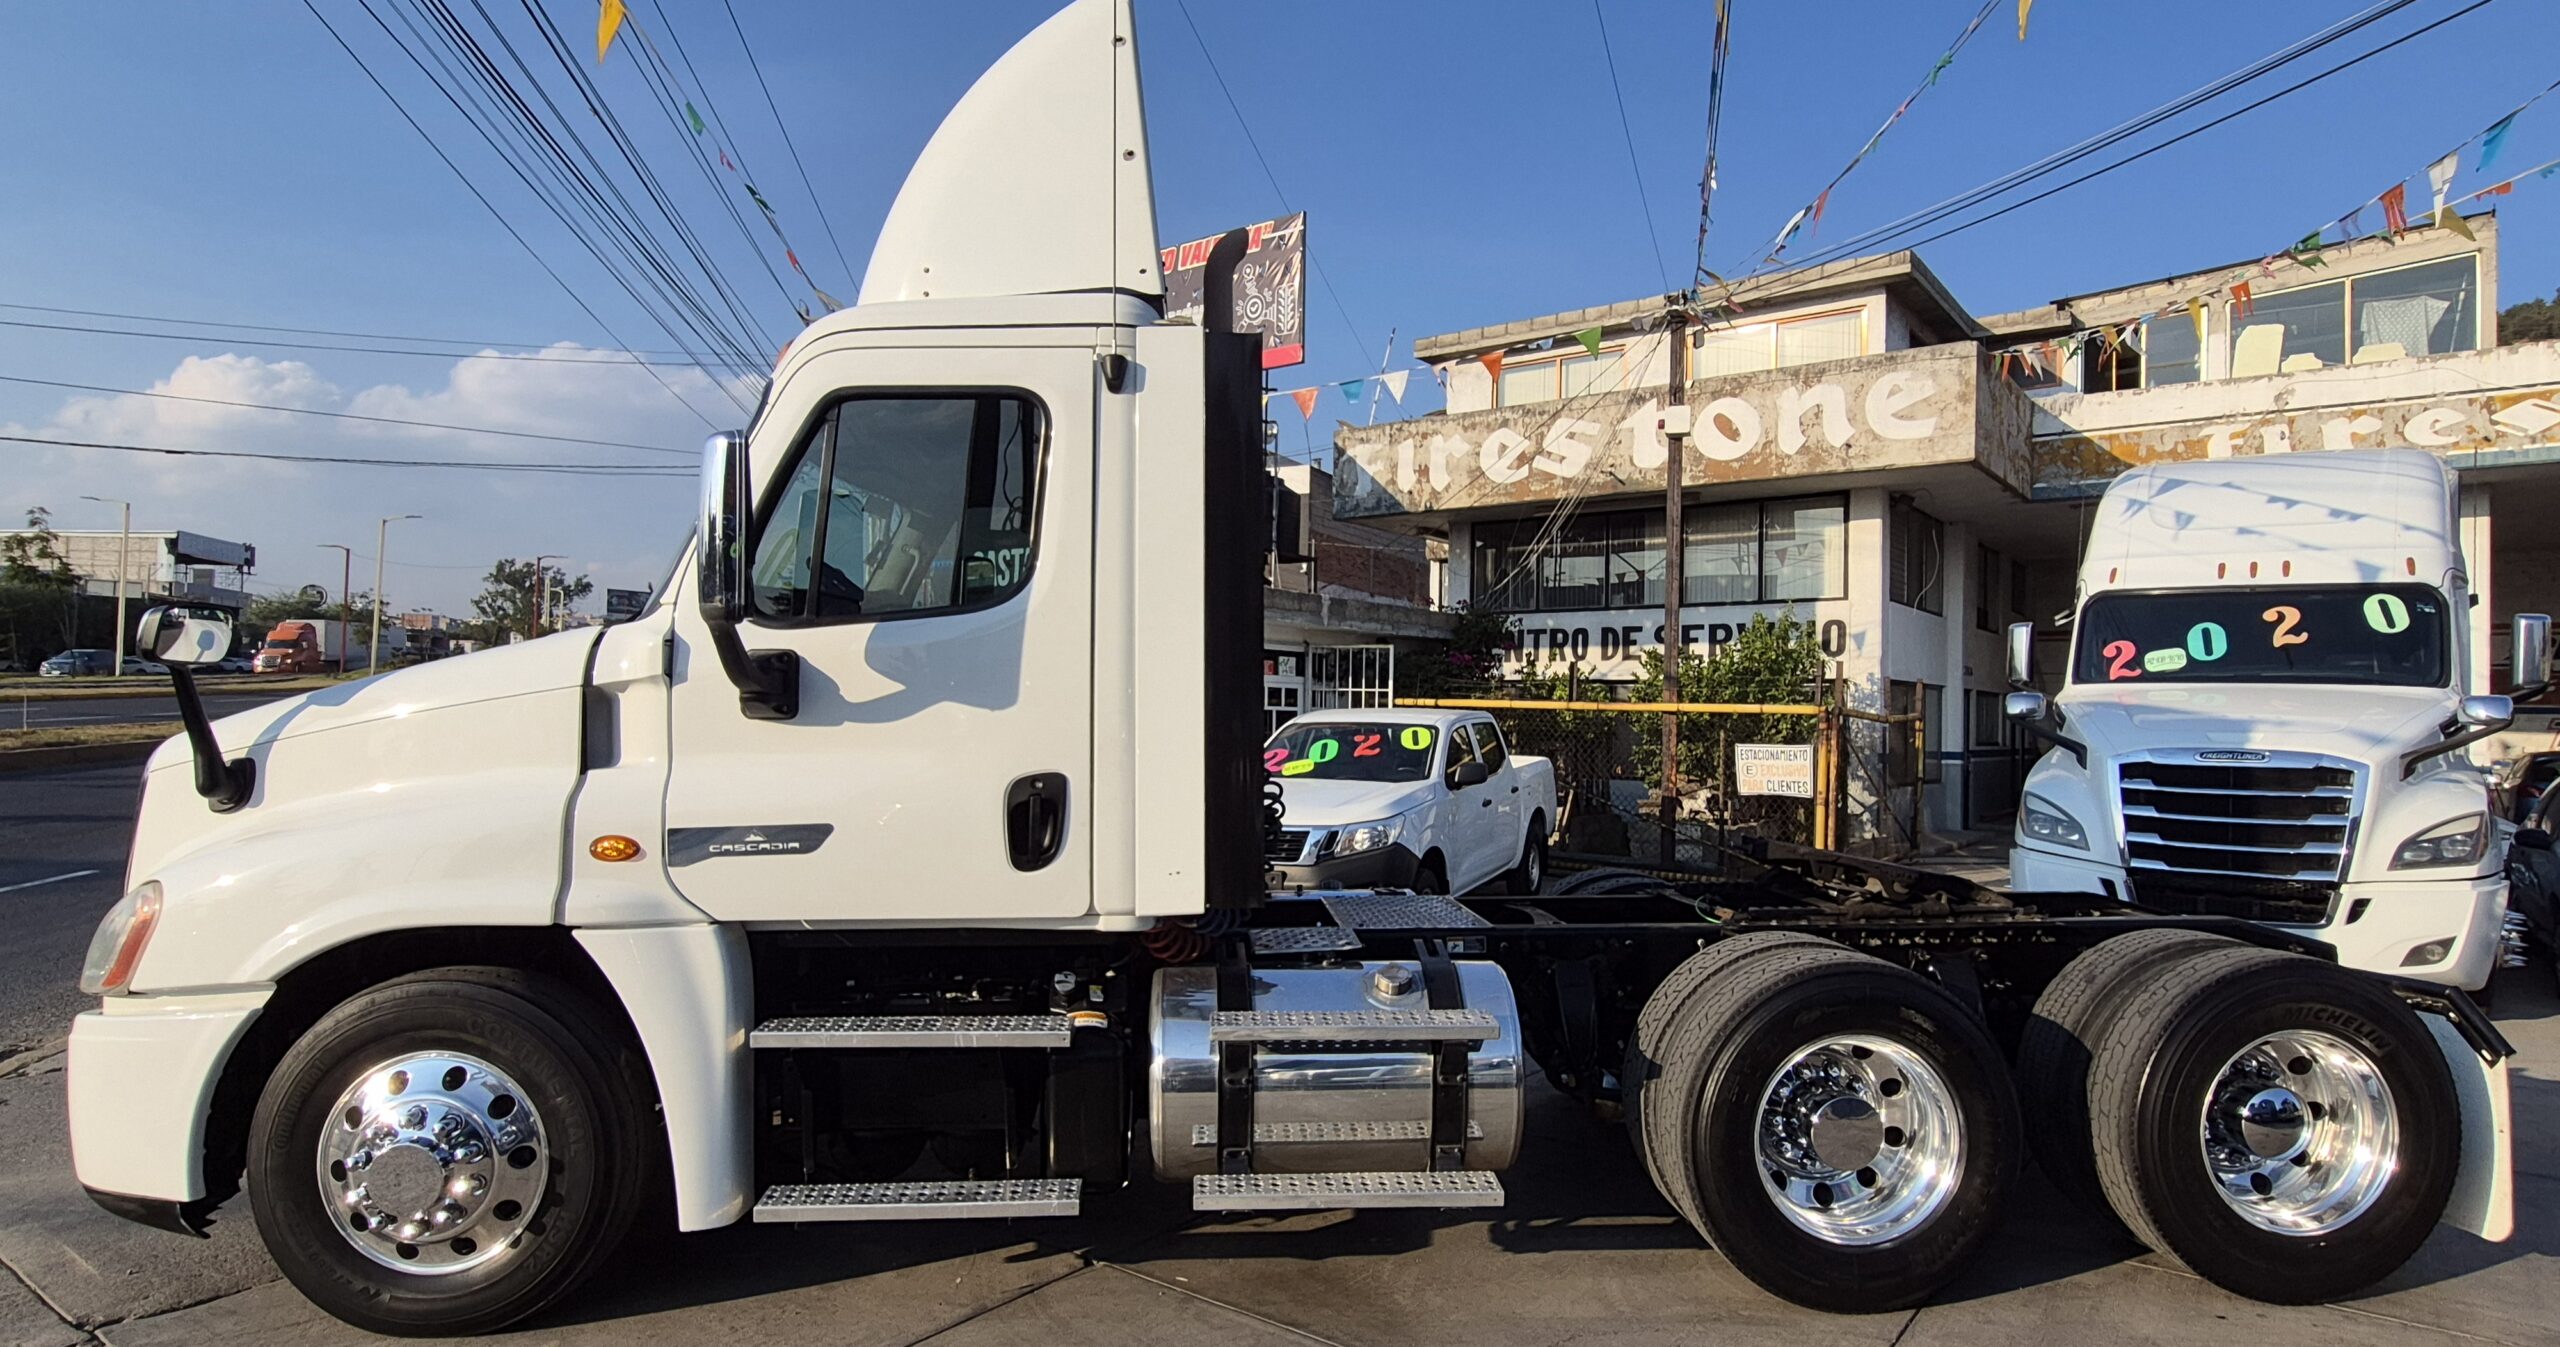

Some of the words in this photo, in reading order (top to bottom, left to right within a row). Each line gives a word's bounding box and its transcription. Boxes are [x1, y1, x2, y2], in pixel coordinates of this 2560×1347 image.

[1503, 627, 1589, 662] NTRO
[1600, 626, 1643, 661] DE
[1740, 749, 1808, 761] ESTACIONAMIENTO
[1760, 765, 1808, 778] EXCLUSIVO
[1743, 779, 1764, 792] PARA
[1766, 780, 1809, 794] CLIENTES
[709, 842, 800, 853] CASCADIA
[2284, 1004, 2392, 1051] MICHELIN
